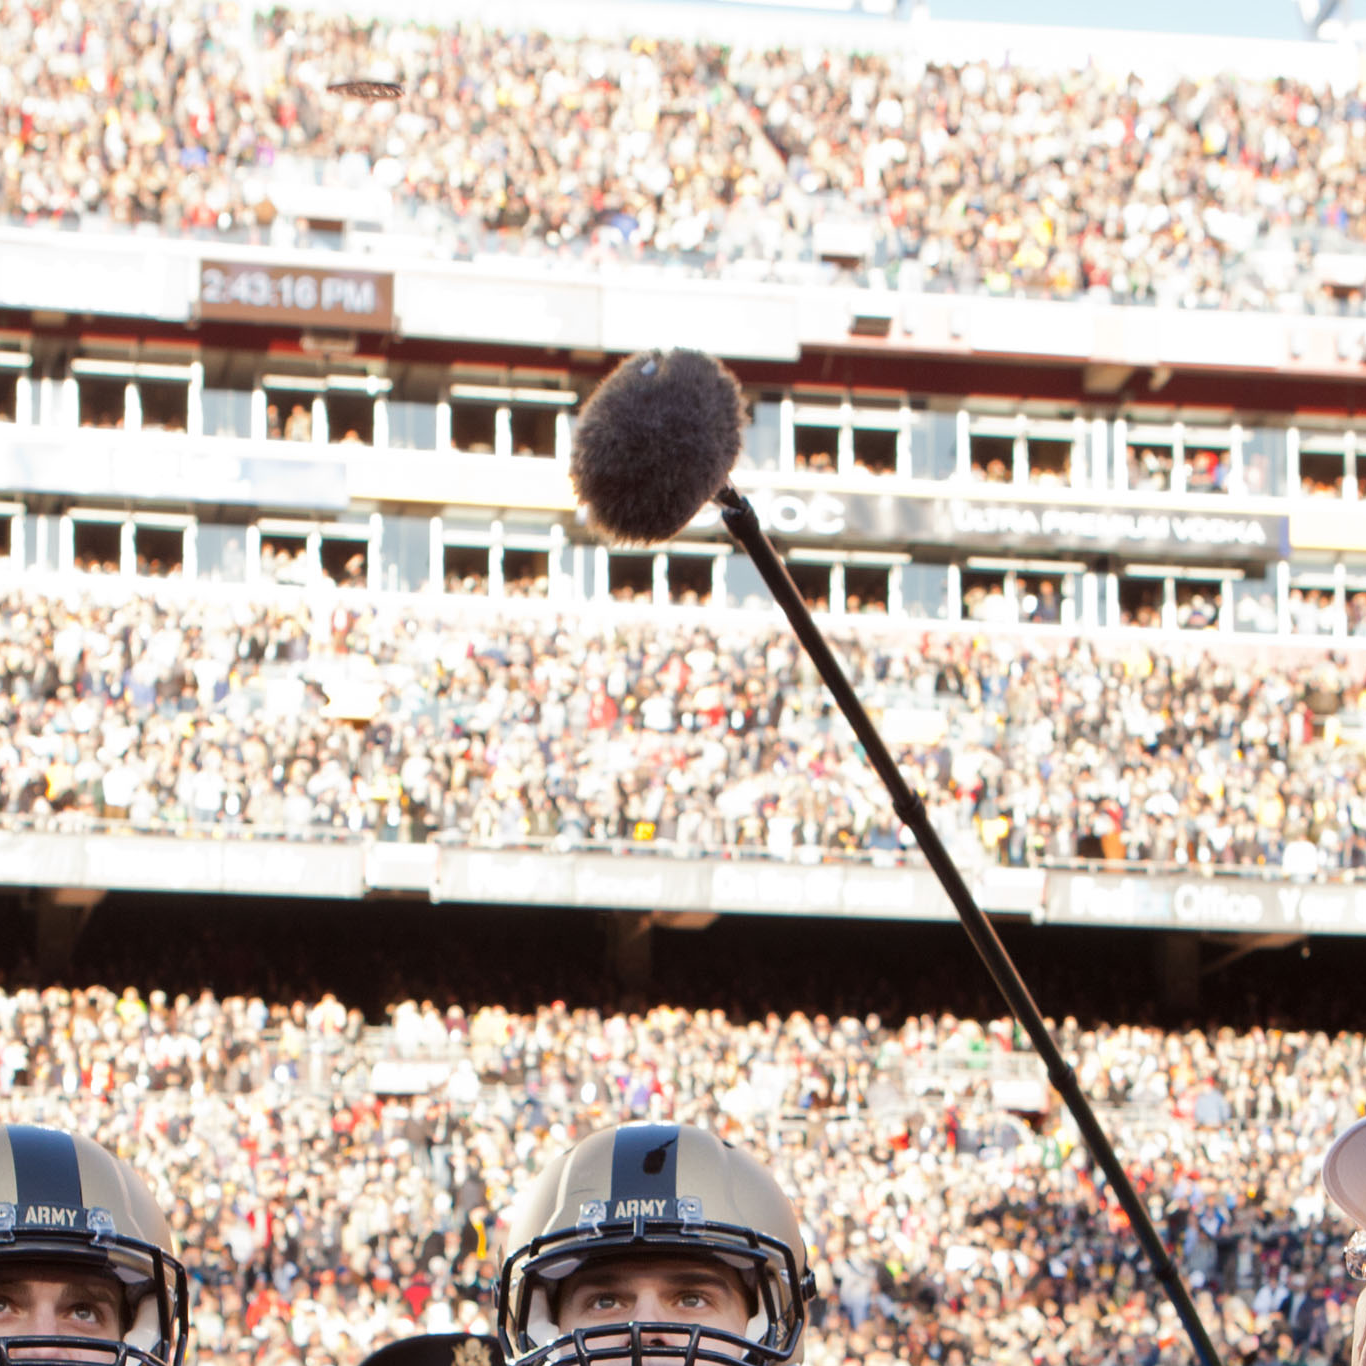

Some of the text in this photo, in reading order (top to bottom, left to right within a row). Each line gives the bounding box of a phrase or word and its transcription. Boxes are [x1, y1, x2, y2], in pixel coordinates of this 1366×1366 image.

[321, 277, 375, 314] PM
[1041, 510, 1169, 541] PREMIUM
[1172, 517, 1267, 544] VODKA
[1070, 878, 1263, 923] FedEx Office
[25, 1205, 77, 1227] ARMY
[614, 1199, 667, 1219] ARMY
